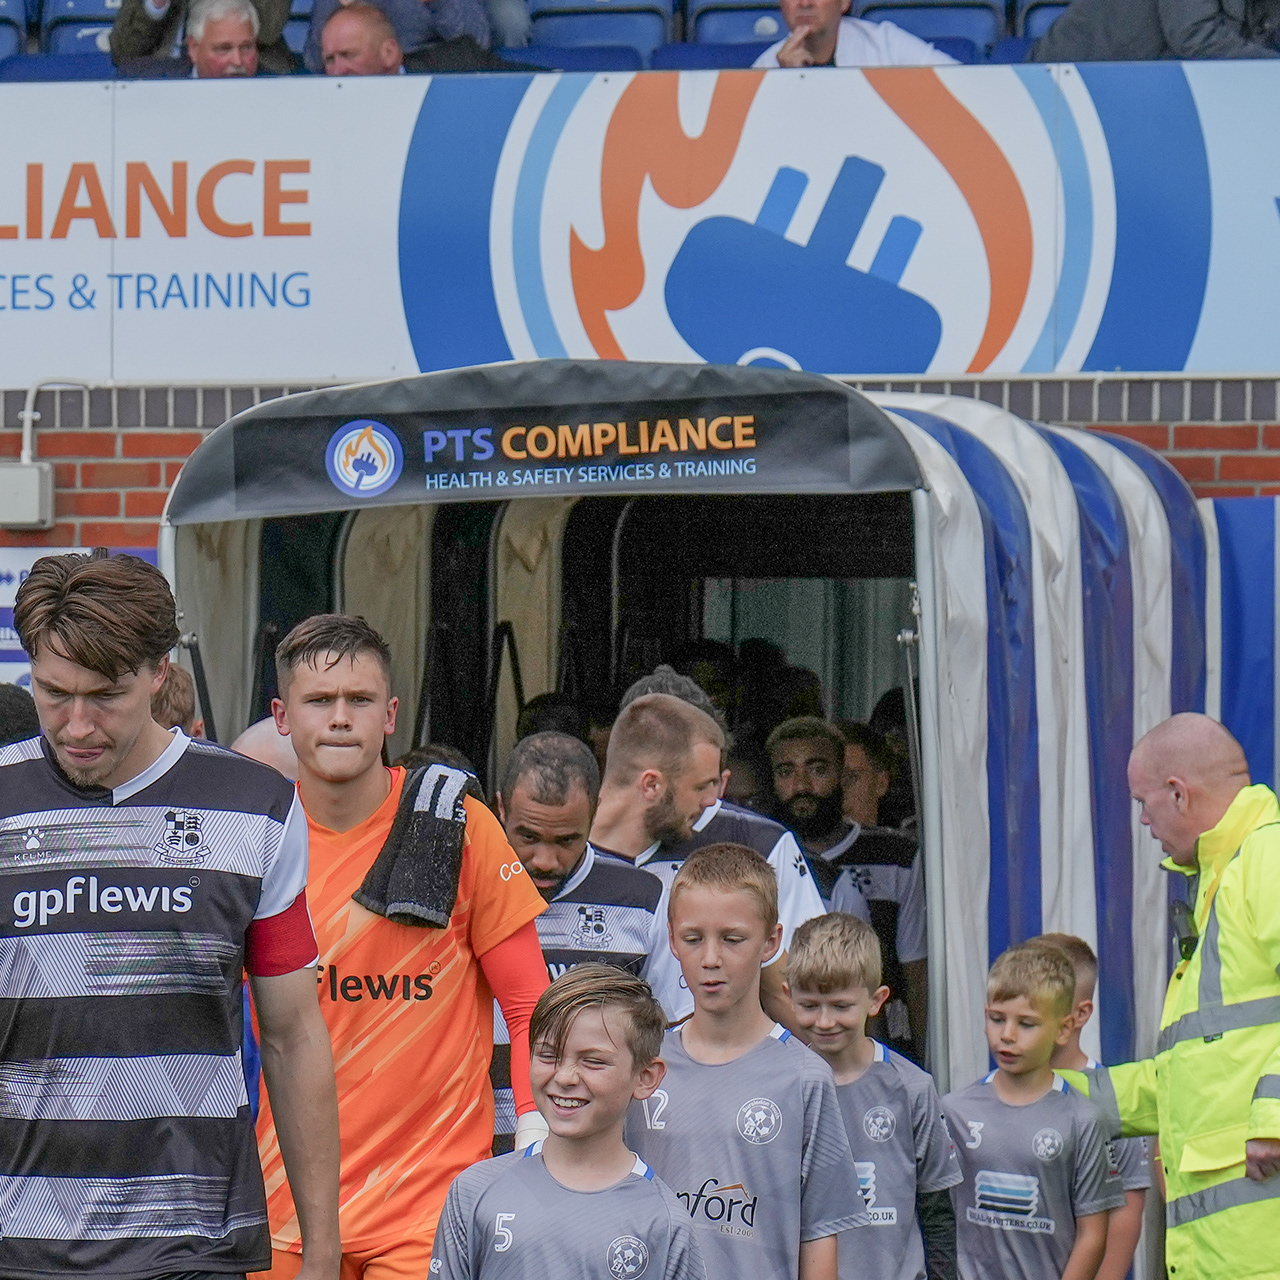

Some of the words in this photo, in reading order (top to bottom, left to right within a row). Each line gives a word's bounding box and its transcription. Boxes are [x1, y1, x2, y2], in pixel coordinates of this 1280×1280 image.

[67, 272, 97, 310] &
[107, 271, 311, 310] TRAINING
[424, 428, 495, 463] PTS
[501, 415, 757, 460] COMPLIANCE
[425, 471, 493, 490] HEALTH
[496, 470, 509, 487] &
[512, 465, 574, 486] SAFETY
[578, 462, 654, 483] SERVICES
[657, 461, 670, 478] &
[674, 458, 757, 478] TRAINING
[13, 875, 193, 928] gpflewis
[318, 963, 433, 1002] lewis
[966, 1120, 985, 1149] 3
[494, 1212, 516, 1252] 5
